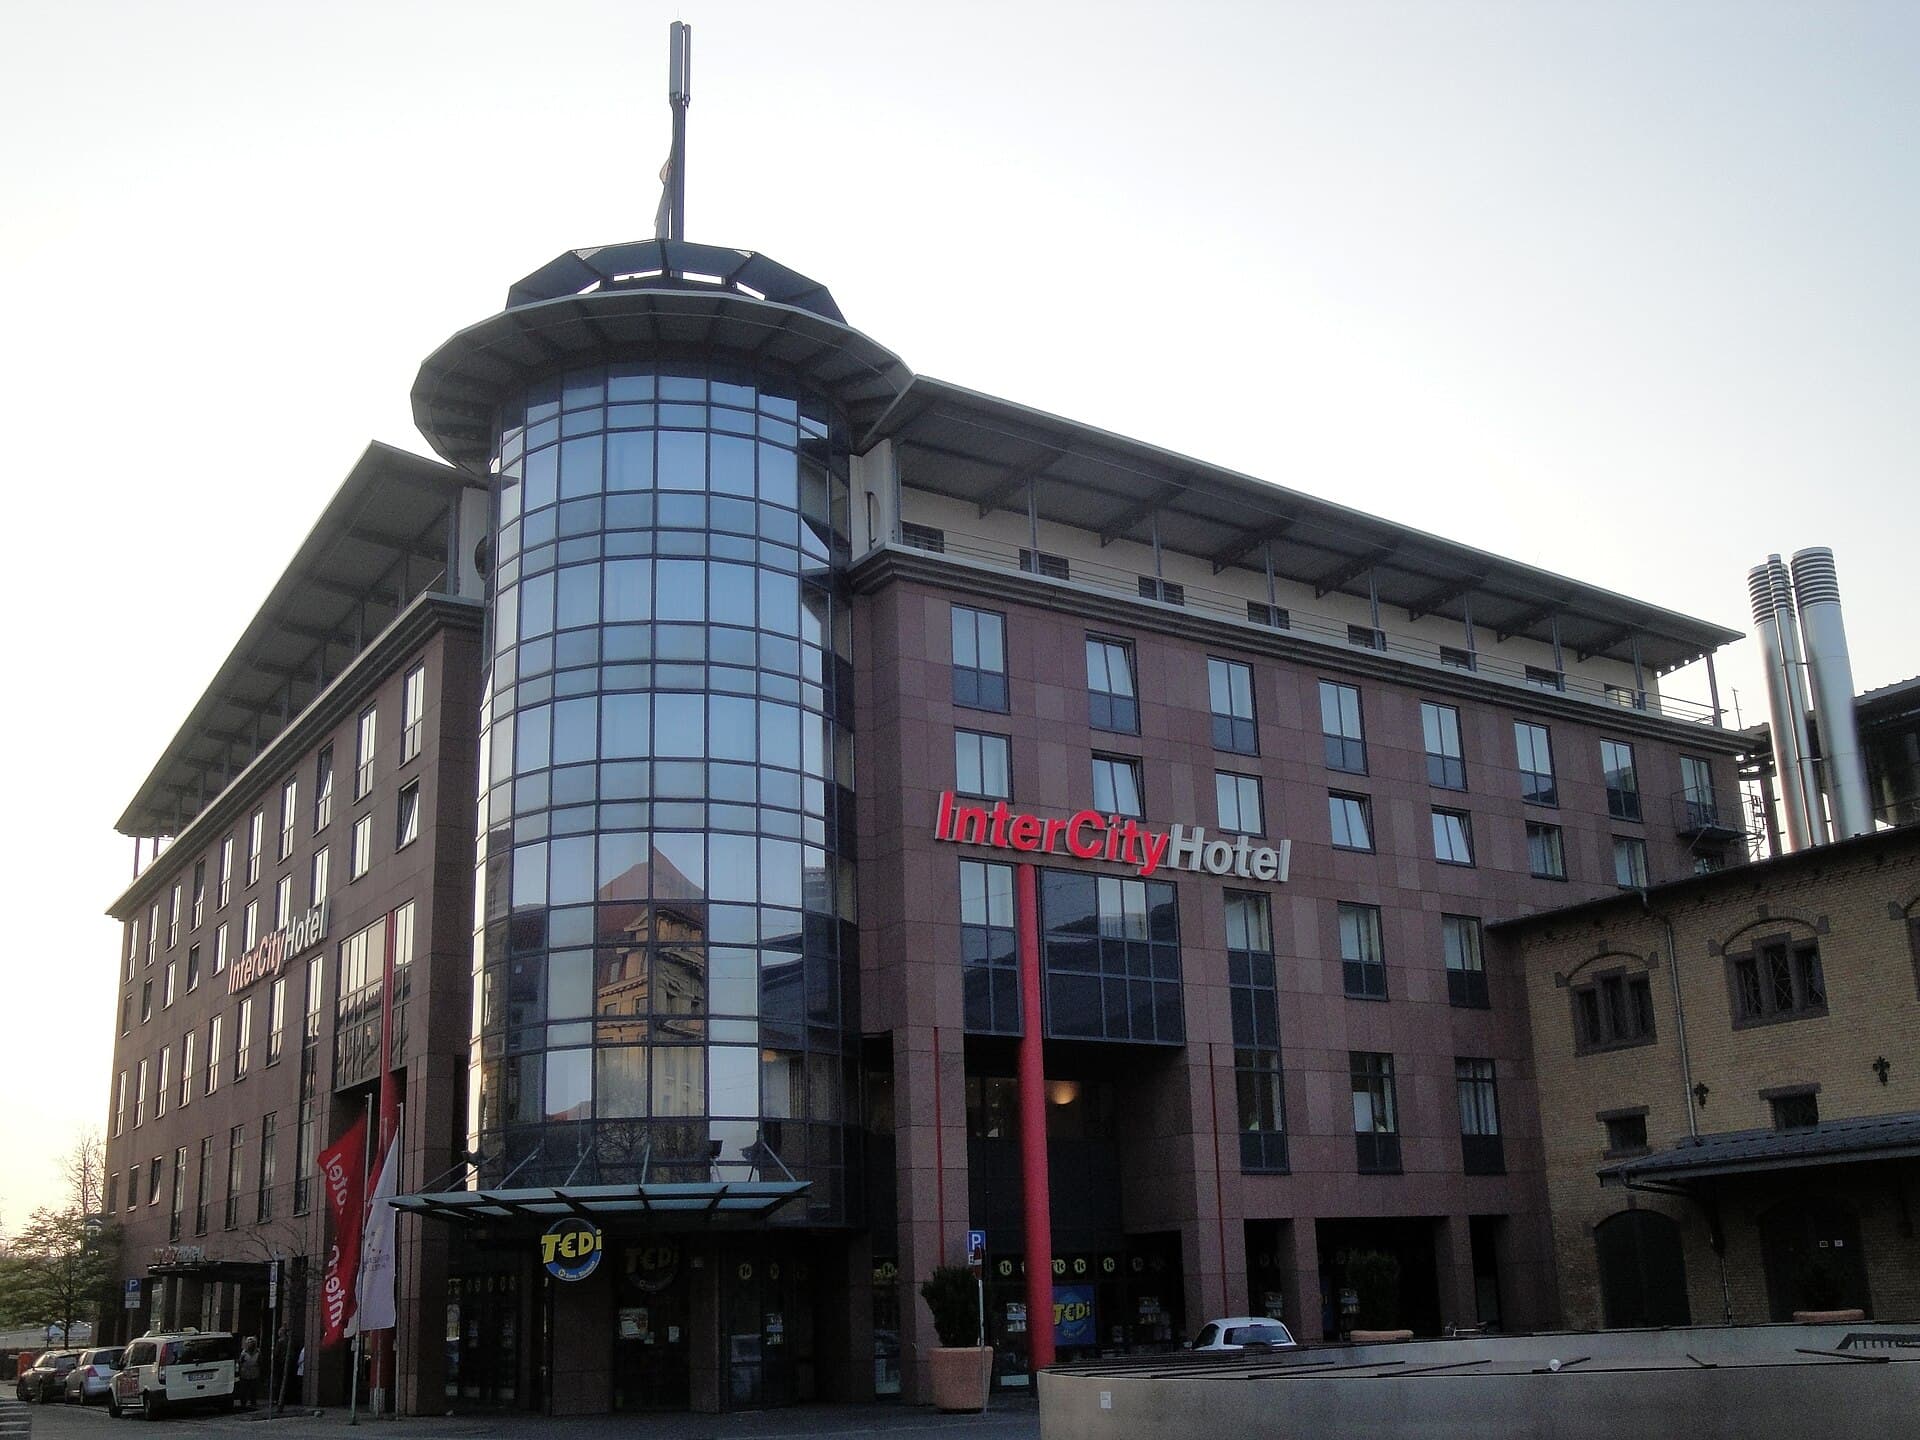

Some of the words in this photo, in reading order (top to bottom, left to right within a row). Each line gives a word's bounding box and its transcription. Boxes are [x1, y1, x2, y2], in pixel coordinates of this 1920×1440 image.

[935, 790, 1291, 882] InterCityHotel
[227, 896, 330, 995] InterCityHotel
[971, 1233, 982, 1250] P
[129, 1279, 138, 1291] P
